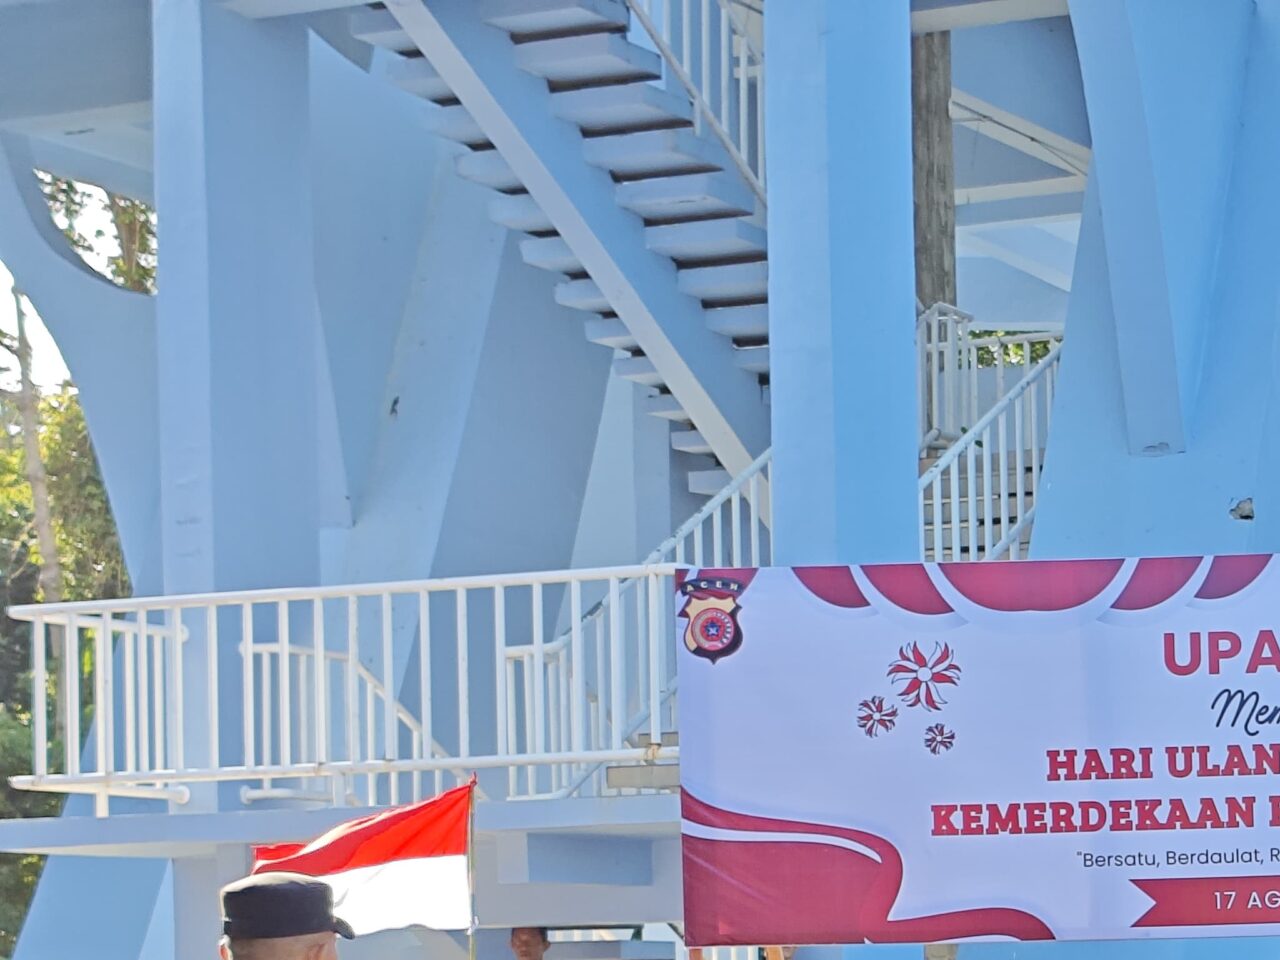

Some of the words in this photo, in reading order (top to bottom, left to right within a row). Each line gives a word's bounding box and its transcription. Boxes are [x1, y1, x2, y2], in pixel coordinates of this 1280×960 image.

[686, 581, 739, 591] ACEH
[1046, 746, 1154, 781] HARI
[930, 796, 1257, 836] KEMERDEKAAN
[1076, 851, 1160, 868] "Bersatu,
[1166, 848, 1264, 866] Berdaulat,
[1214, 891, 1237, 910] 17
